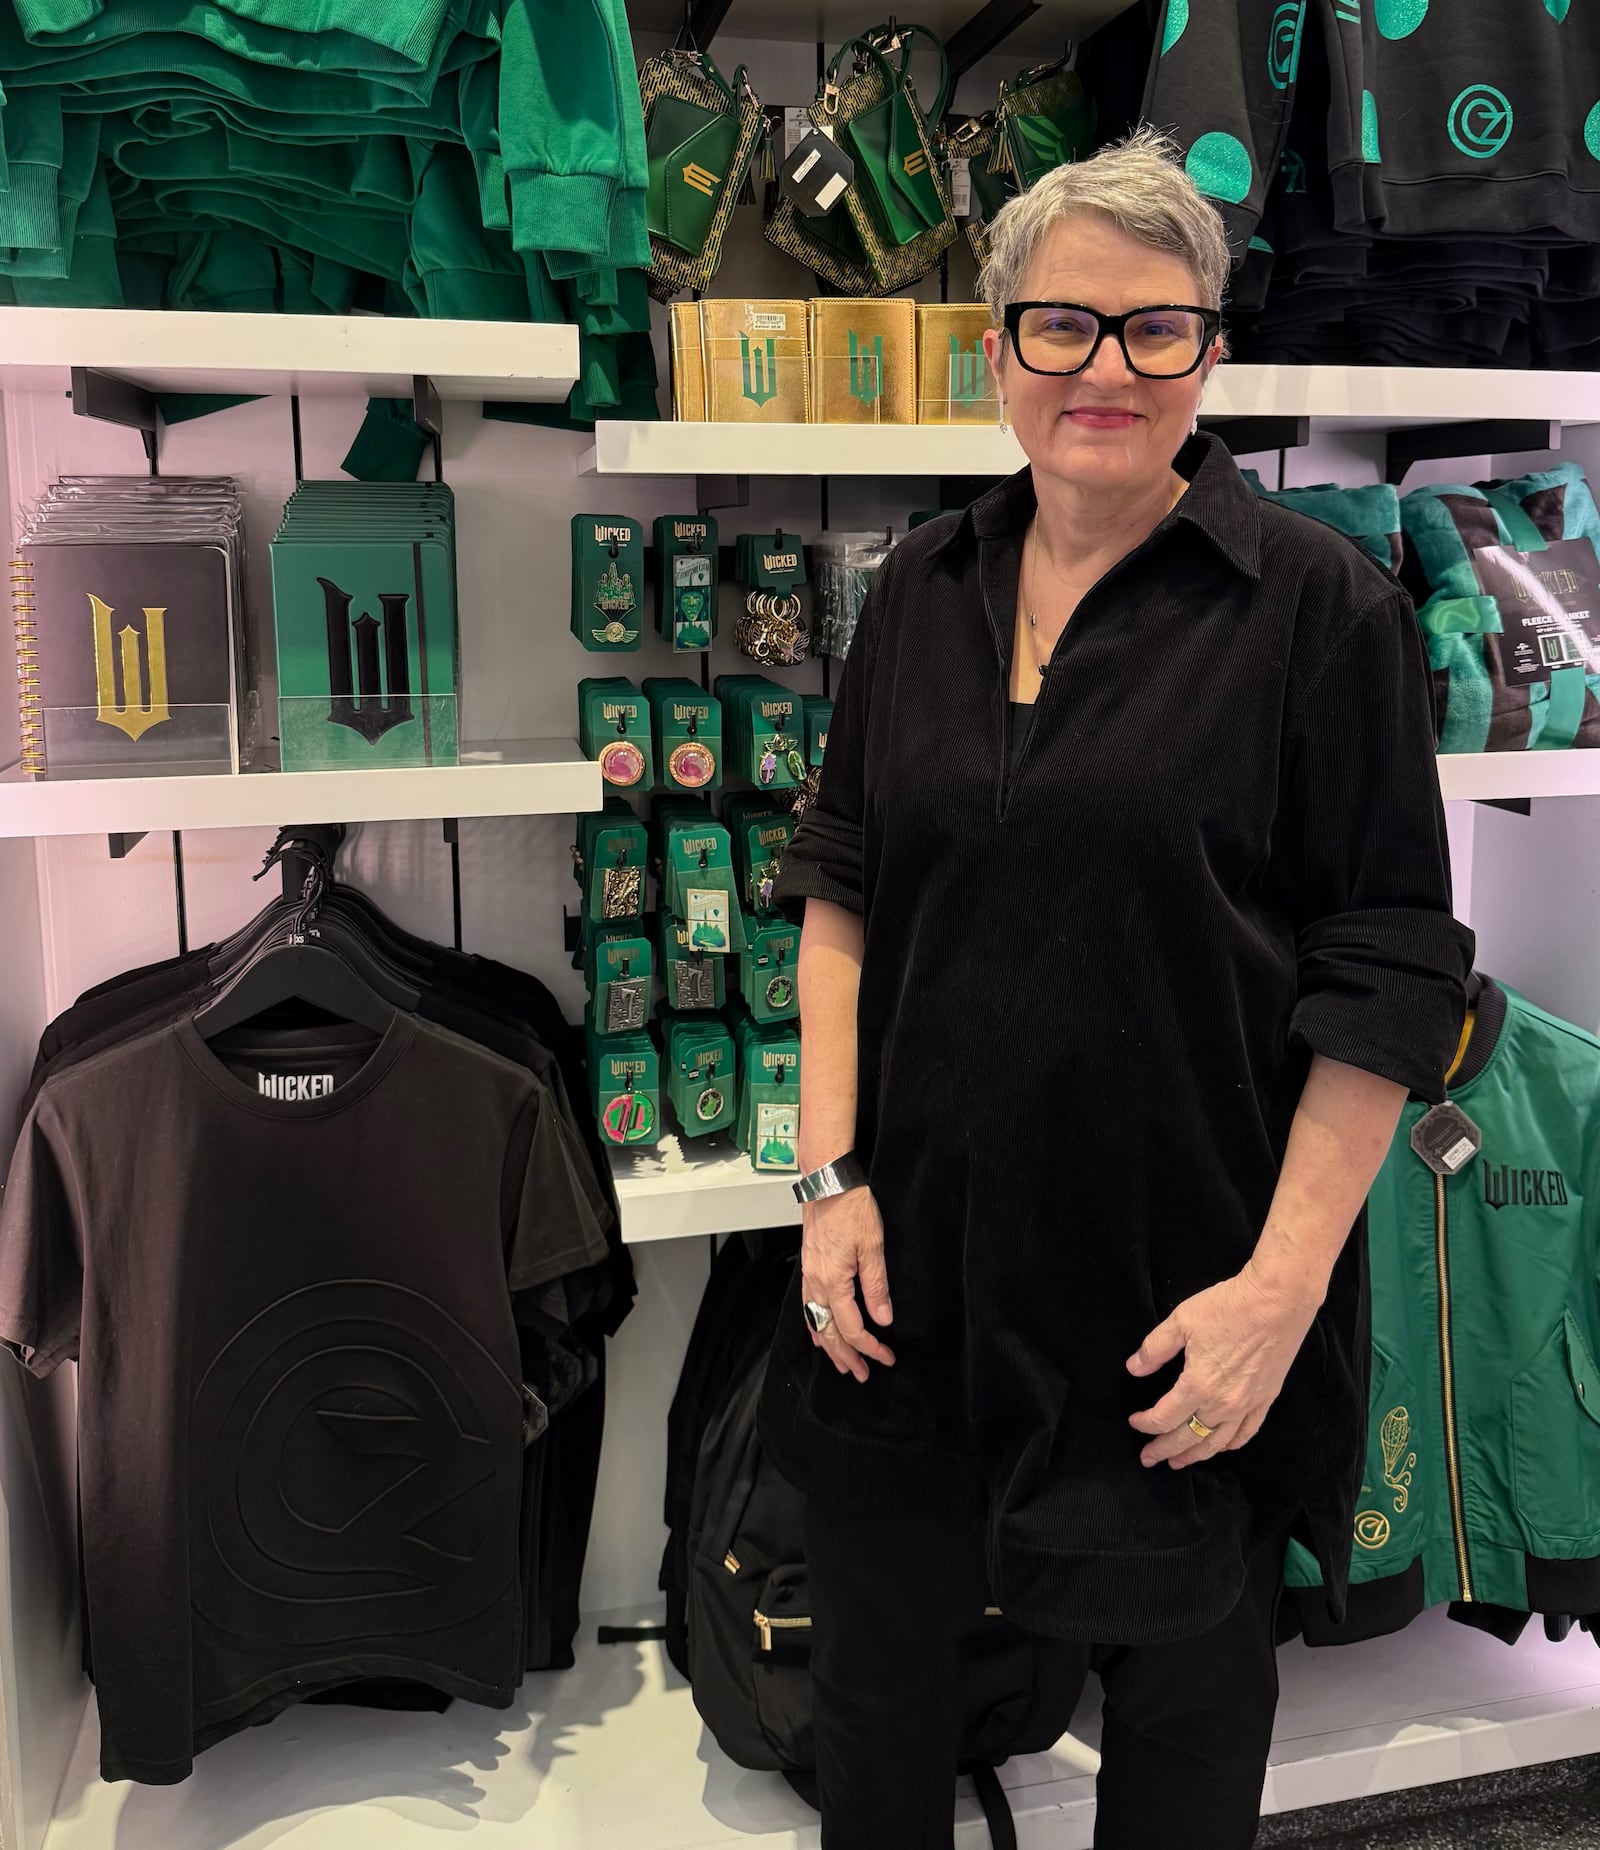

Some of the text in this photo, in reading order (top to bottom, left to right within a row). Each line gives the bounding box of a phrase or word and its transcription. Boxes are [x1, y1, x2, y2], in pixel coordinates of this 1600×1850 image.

[594, 523, 631, 542] WICKED
[673, 520, 707, 538] WICKED
[762, 553, 798, 571] WICKED
[1521, 615, 1554, 627] FLEECE
[602, 702, 637, 720] WICKED
[673, 703, 709, 720] WICKED
[761, 701, 792, 718] WICKED
[758, 826, 787, 846] WICKED
[682, 837, 717, 855] WICKED
[610, 1059, 646, 1075] WICKED
[762, 1050, 797, 1068] WICKED
[258, 1071, 334, 1101] WICKED
[1482, 1158, 1569, 1211] WICKED
